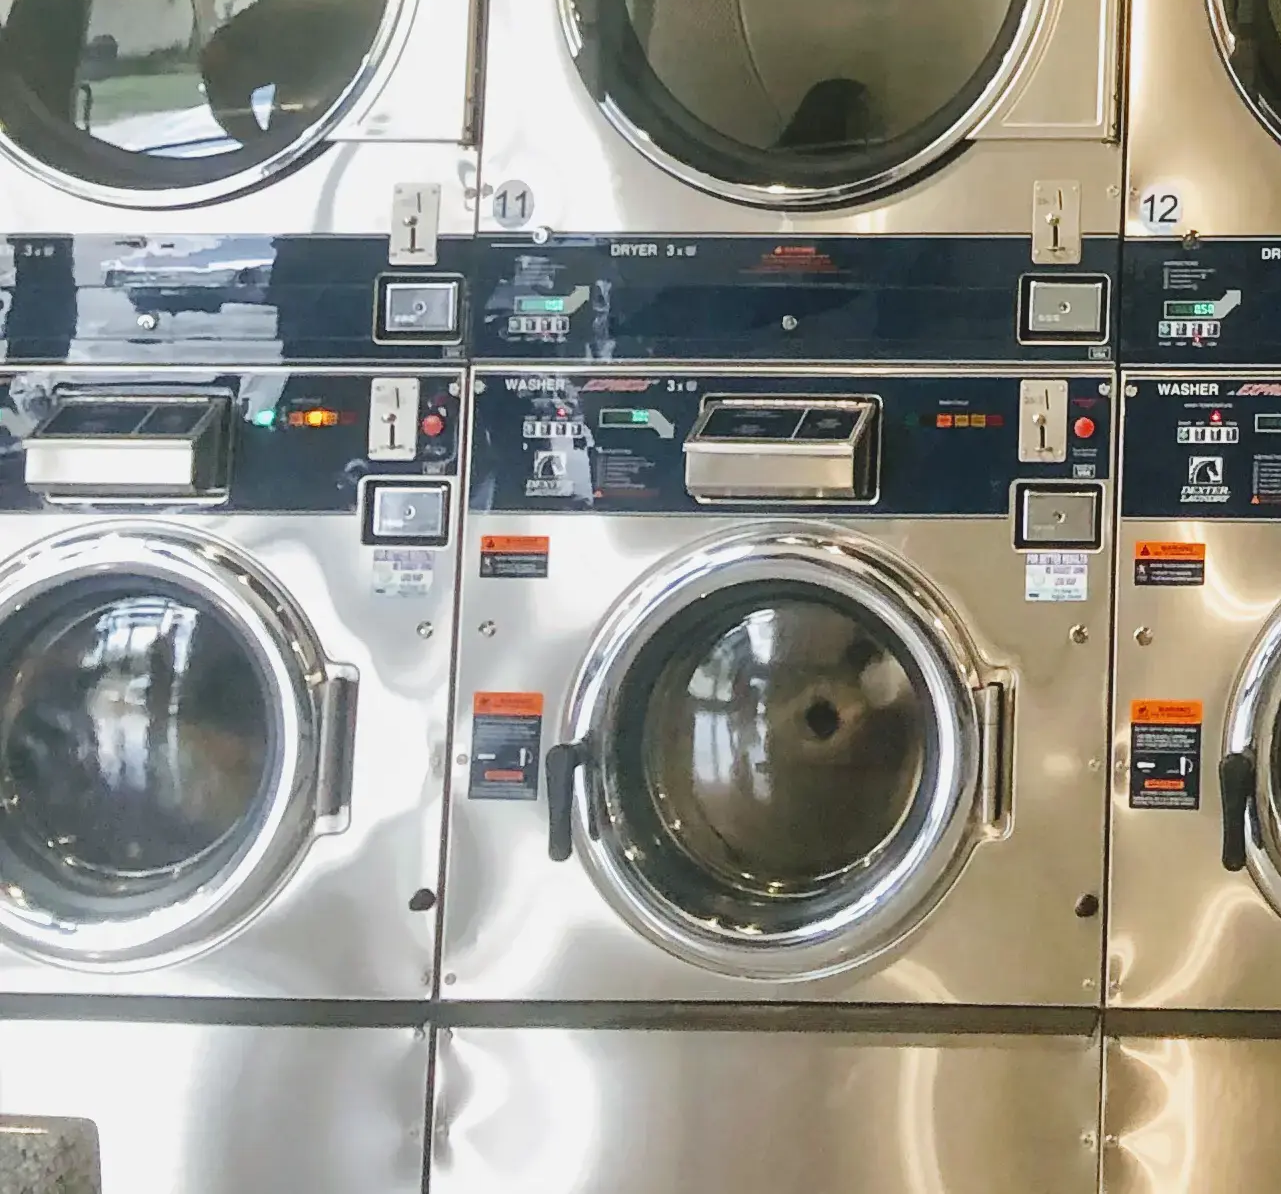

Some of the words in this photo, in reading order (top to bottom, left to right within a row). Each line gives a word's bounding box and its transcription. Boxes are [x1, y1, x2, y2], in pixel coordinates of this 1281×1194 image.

[495, 189, 528, 219] 11
[1142, 194, 1178, 223] 12
[610, 244, 657, 256] DRYER
[505, 378, 565, 391] WASHER
[1157, 383, 1219, 396] WASHER
[1181, 486, 1230, 495] DEXTER
